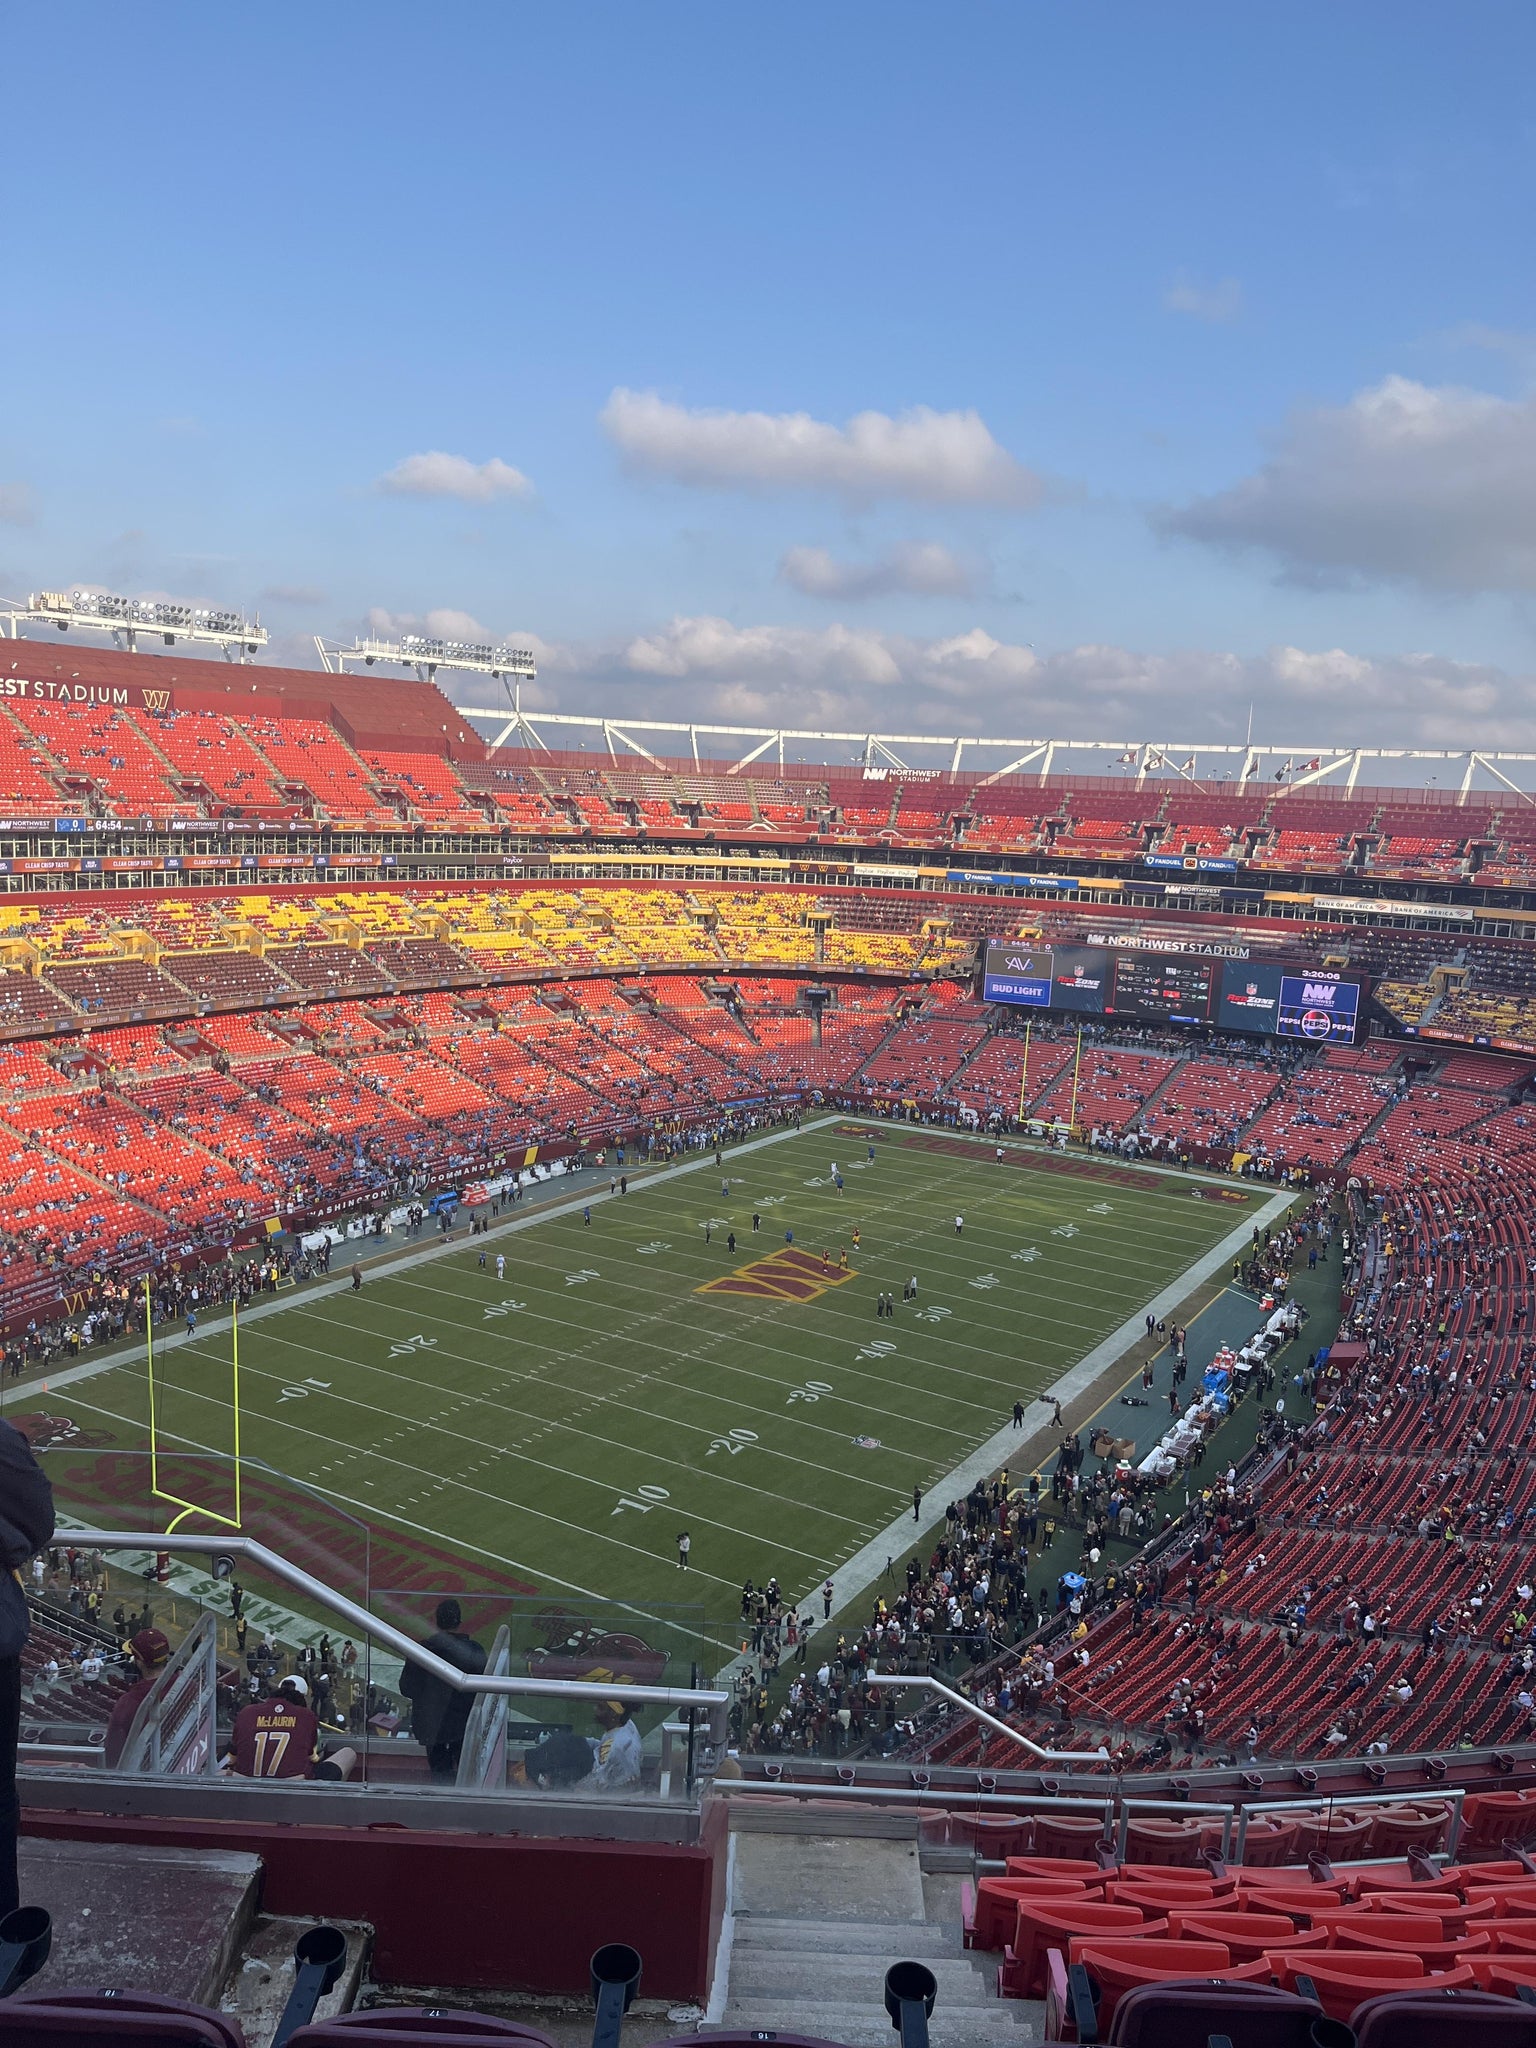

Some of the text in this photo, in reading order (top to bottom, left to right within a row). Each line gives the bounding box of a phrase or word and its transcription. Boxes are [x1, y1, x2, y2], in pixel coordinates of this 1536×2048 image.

[34, 681, 127, 704] STADIUM
[863, 768, 888, 780] NW
[890, 769, 942, 778] NORTHWEST
[73, 820, 79, 828] 0
[96, 820, 122, 830] 64:54
[147, 820, 153, 828] 0
[172, 822, 186, 830] NW
[43, 861, 55, 869] CRISP
[128, 860, 140, 868] CRISP
[503, 856, 523, 864] Paycor
[1187, 859, 1196, 868] 25
[1164, 885, 1181, 894] NW
[1087, 934, 1250, 957] NW NORTHWEST STADIUM
[992, 983, 1043, 997] BUD LIGHT
[1303, 983, 1336, 1000] NW
[1302, 997, 1335, 1005] NORTHWEST
[1280, 1017, 1300, 1025] PEPSI
[1304, 1020, 1329, 1029] PEPSI
[1332, 1023, 1354, 1032] PEPSI
[902, 1136, 1160, 1187] COMMANDERS
[430, 1158, 507, 1183] COMMANDERS
[1087, 1203, 1113, 1215] 10
[1050, 1225, 1080, 1238] 20
[636, 1241, 672, 1254] 50
[1010, 1248, 1042, 1262] 30
[565, 1269, 600, 1283] 40
[968, 1276, 1000, 1290] 40
[484, 1299, 527, 1317] 30
[915, 1305, 952, 1322] 50
[390, 1334, 438, 1354] 20
[860, 1340, 896, 1358] 40
[281, 1376, 333, 1398] 10
[790, 1381, 833, 1402] 30
[710, 1428, 758, 1454] 20
[618, 1485, 670, 1514] 10
[188, 1579, 297, 1635] TAKES
[257, 1716, 296, 1727] McLAURIN
[253, 1731, 291, 1777] 17
[758, 2032, 769, 2040] 16
